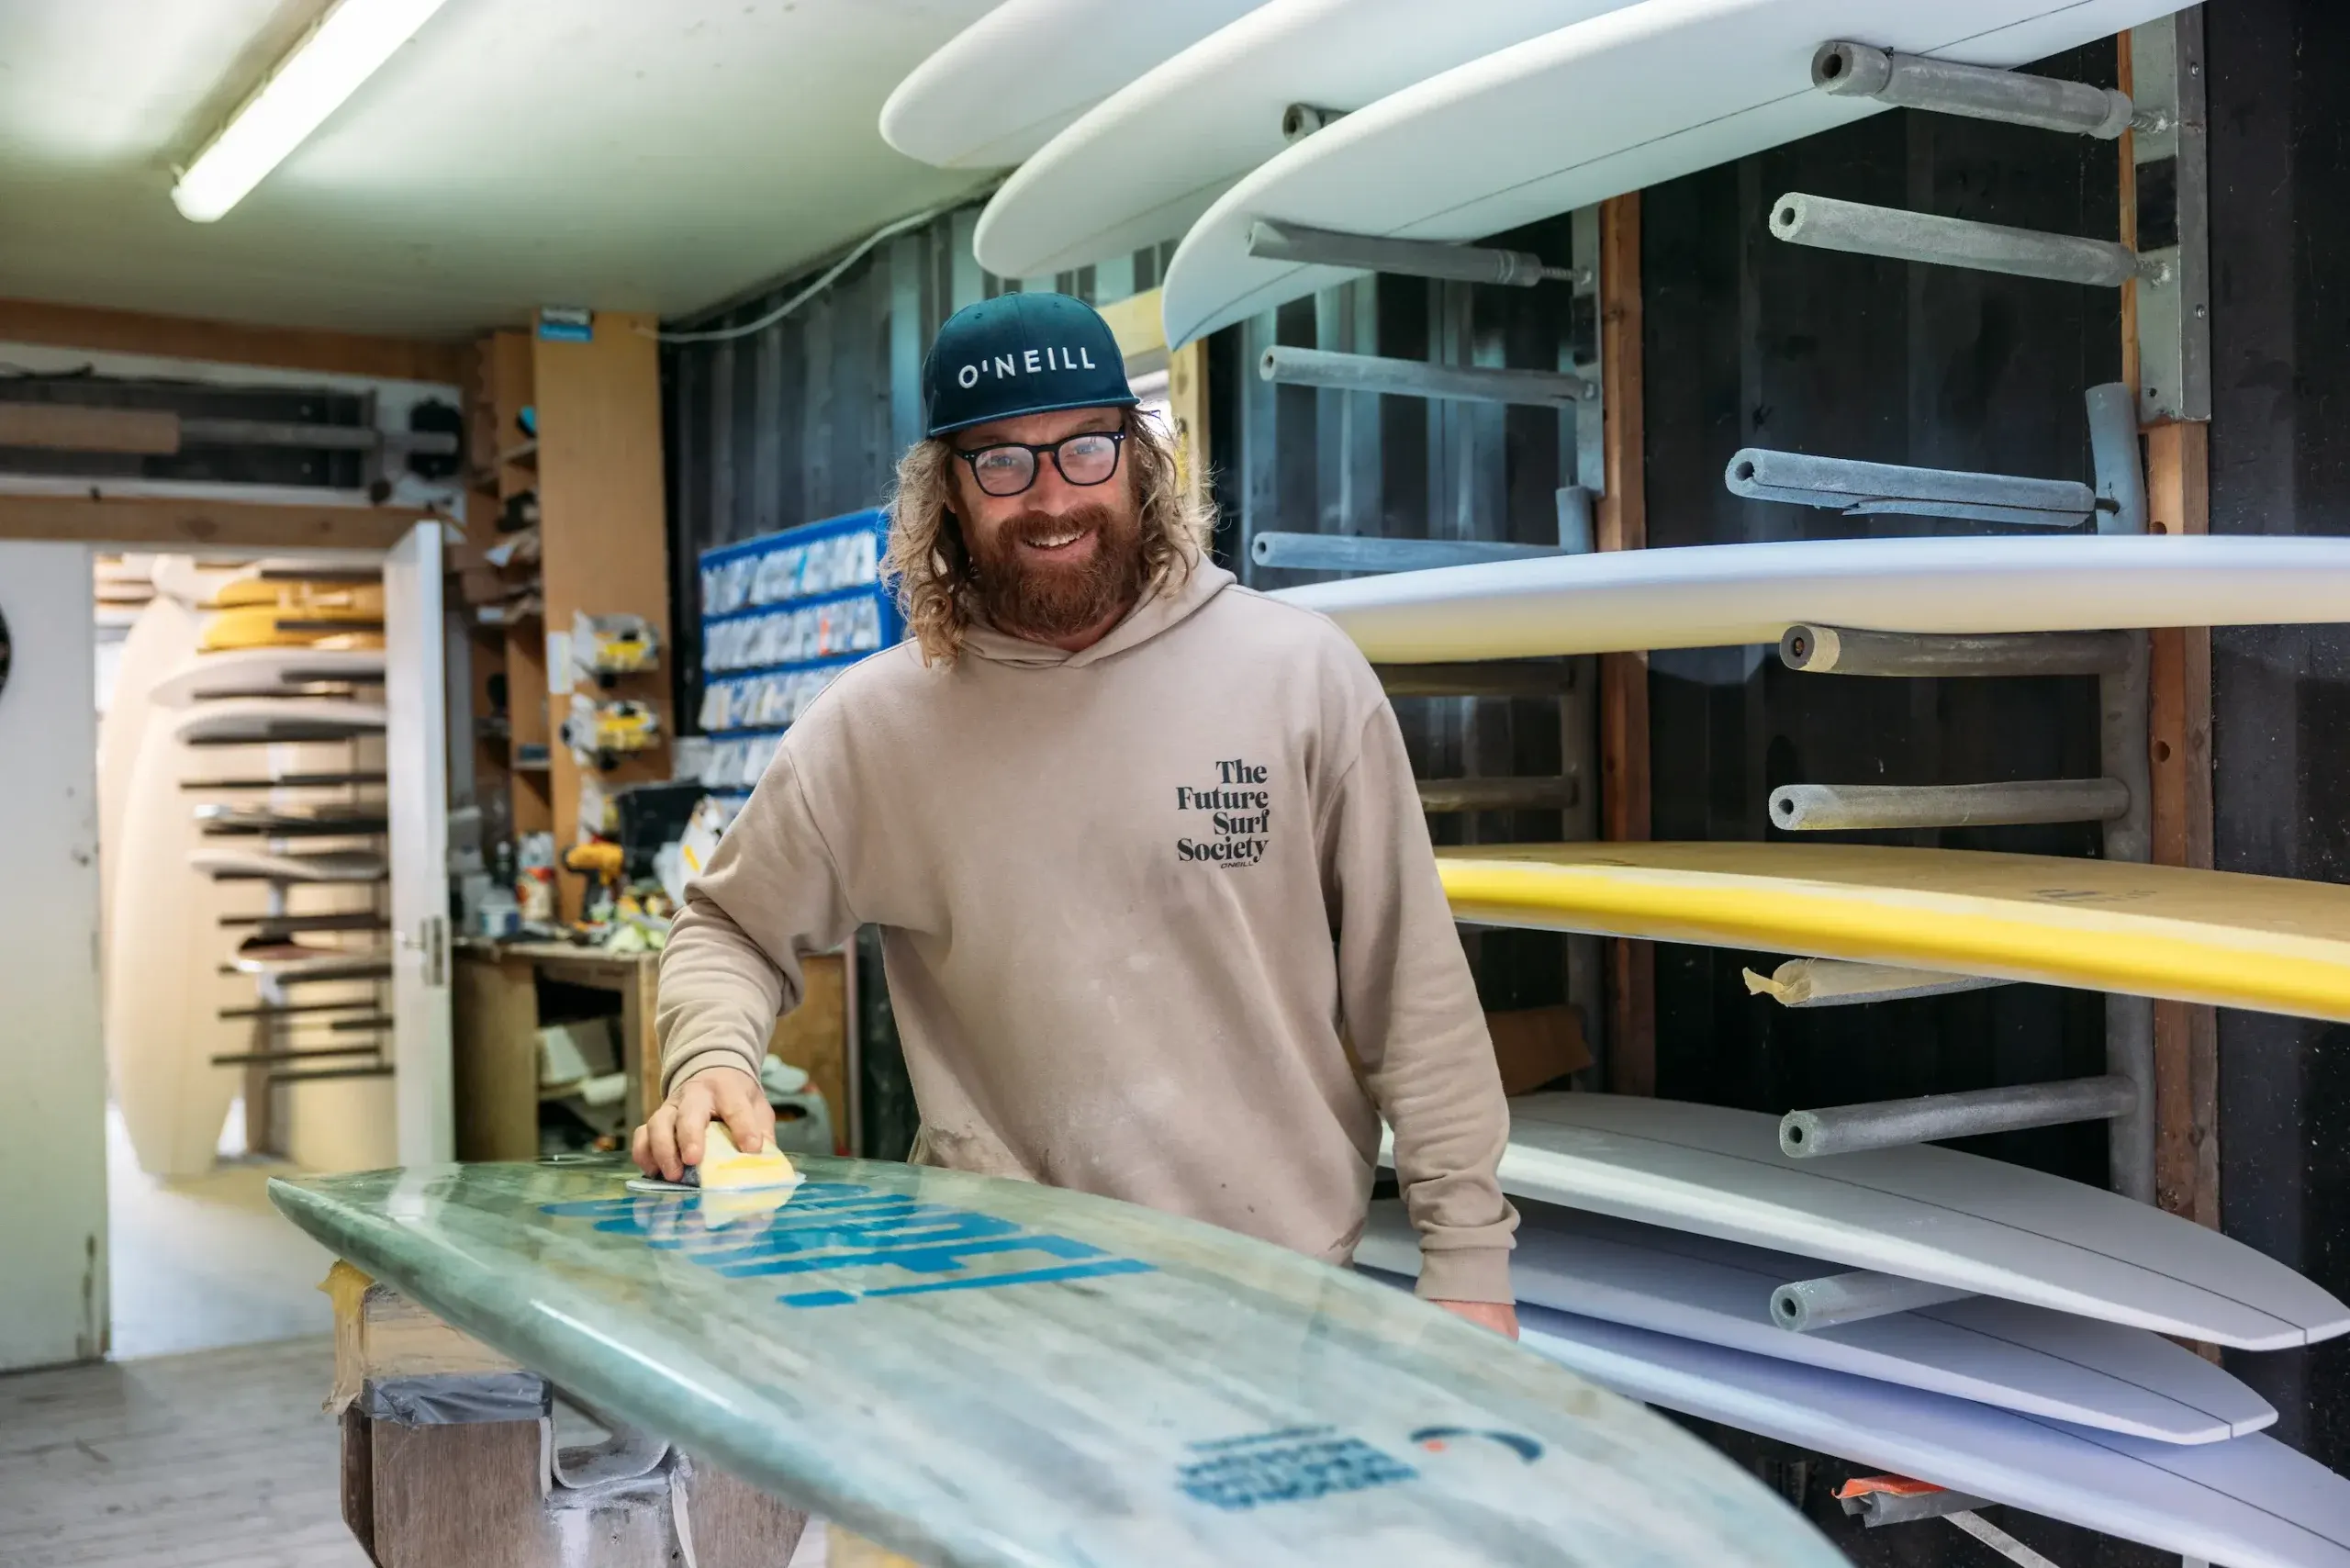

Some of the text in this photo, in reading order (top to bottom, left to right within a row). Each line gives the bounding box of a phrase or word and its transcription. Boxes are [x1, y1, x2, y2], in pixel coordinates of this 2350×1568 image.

[958, 347, 1096, 389] O'NEILL
[1215, 758, 1269, 784] The
[1176, 786, 1270, 811] Future
[1213, 809, 1270, 835] Surf
[1177, 835, 1270, 863] Society
